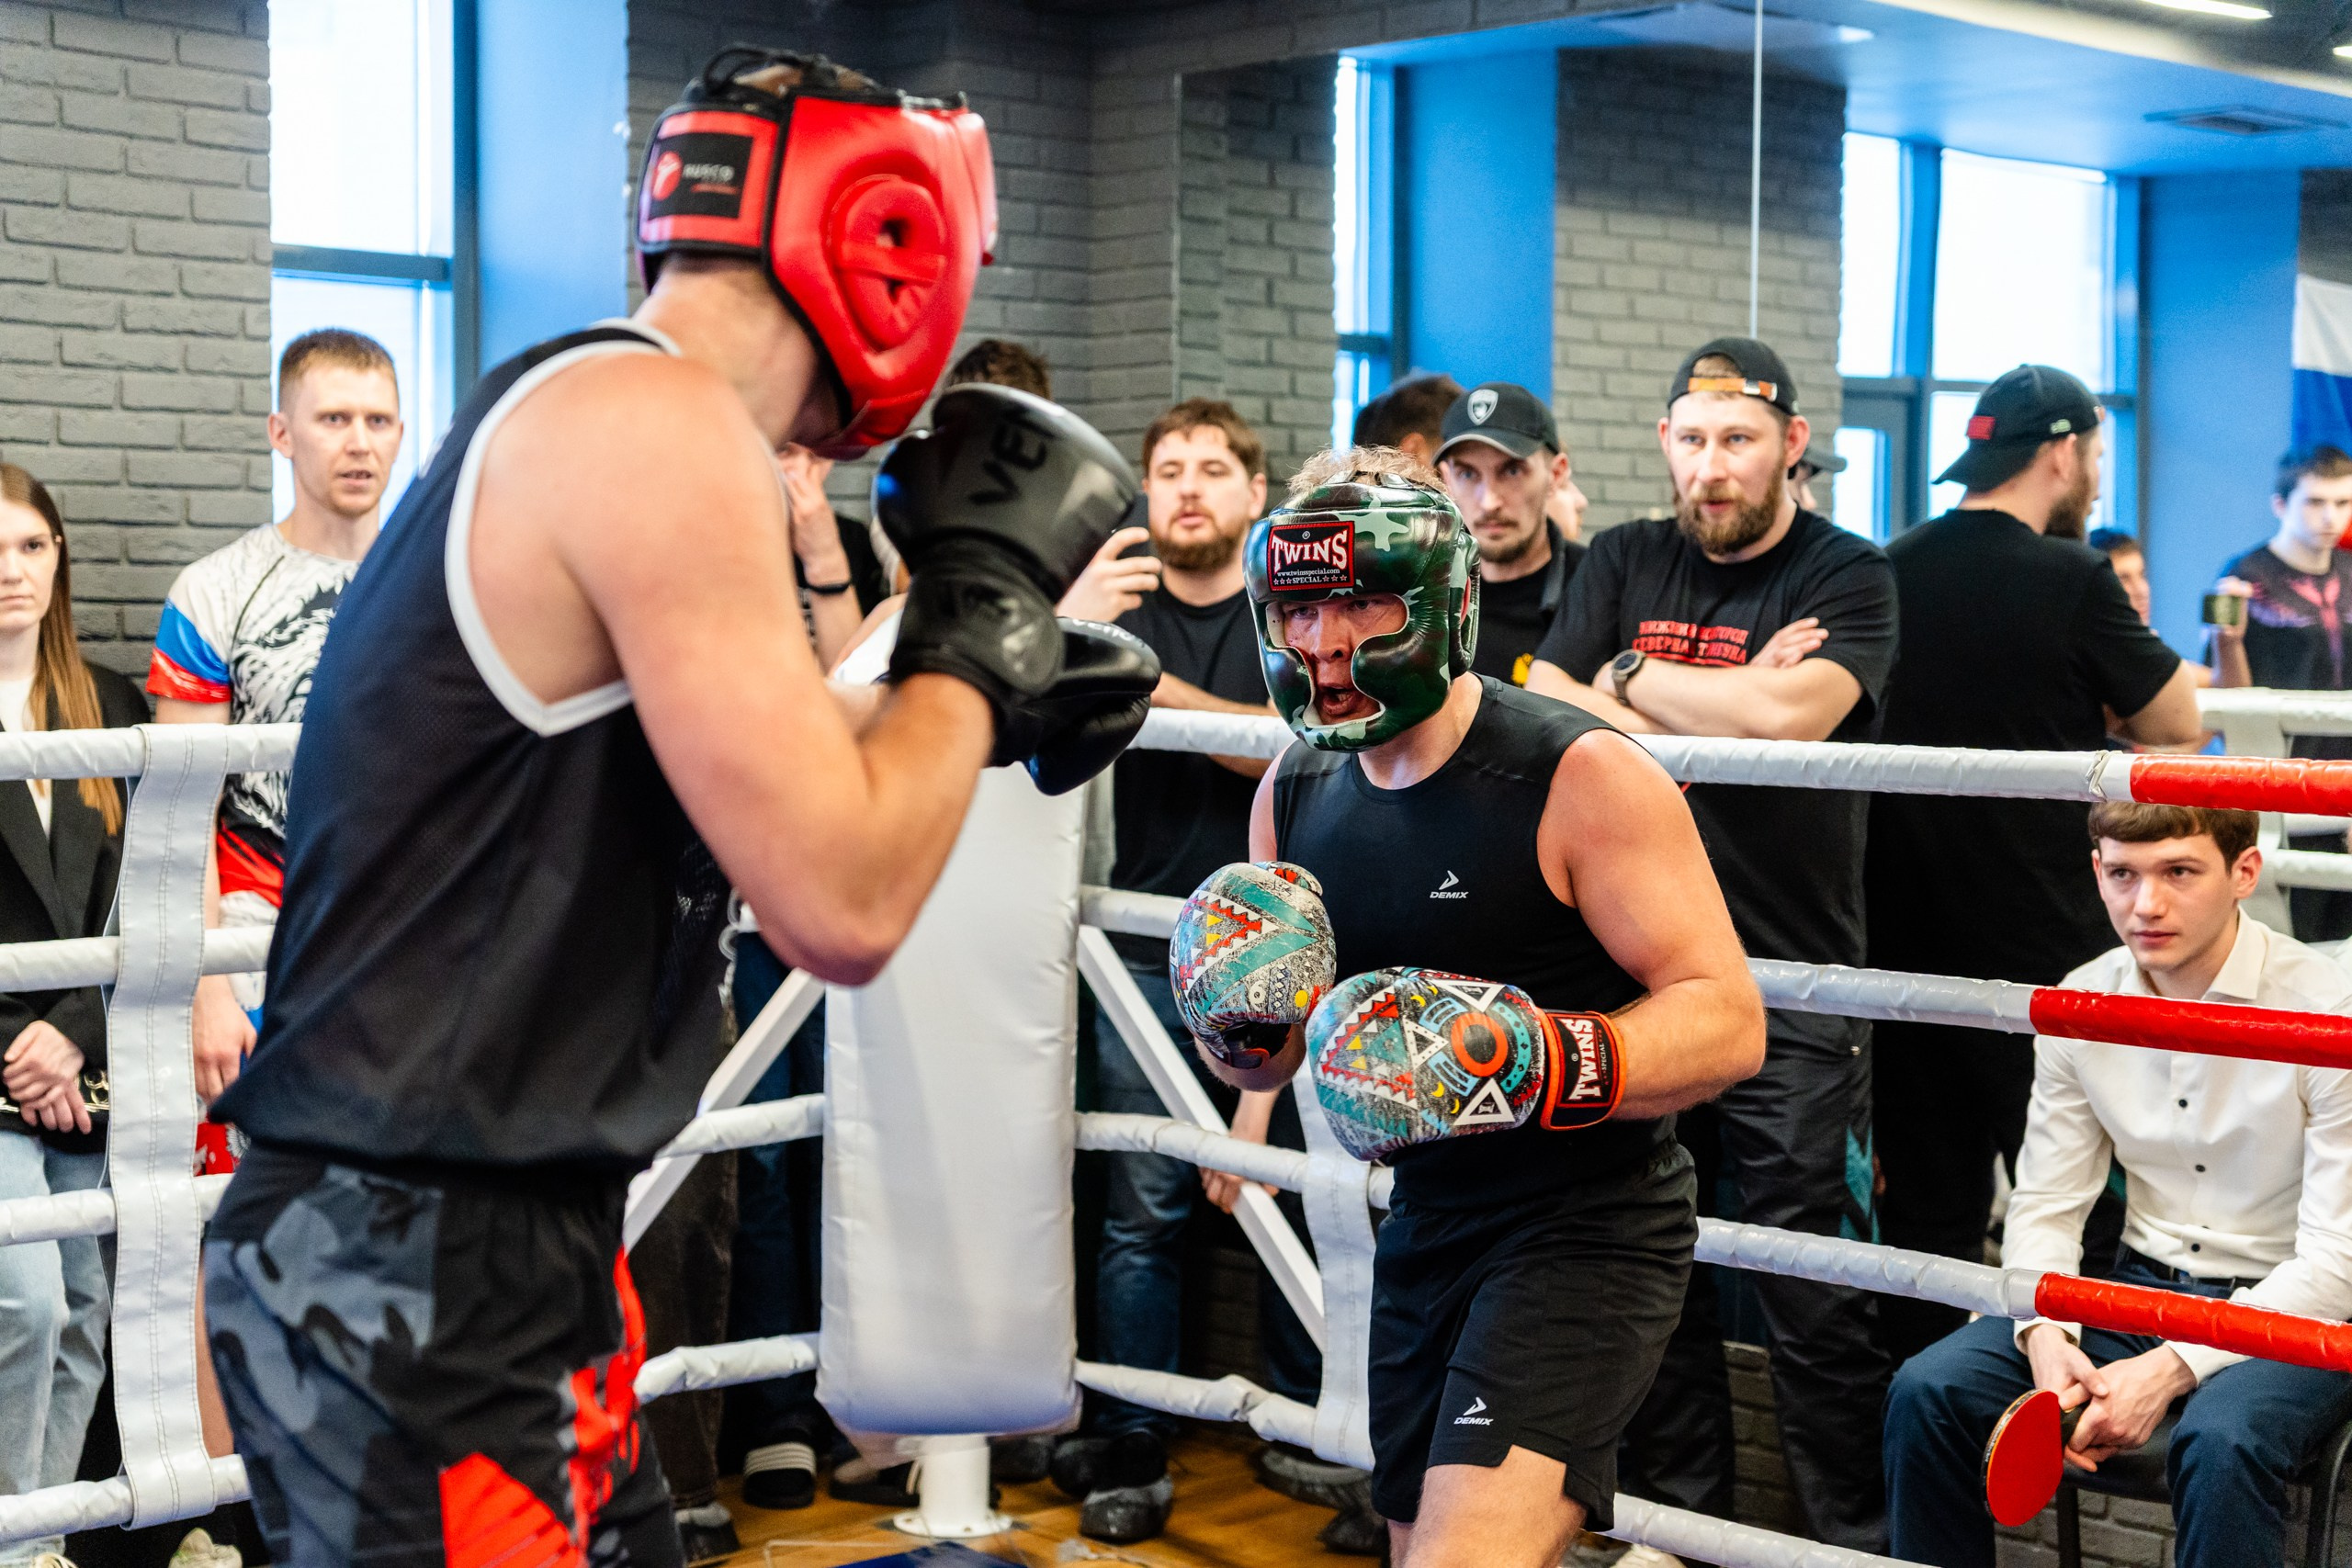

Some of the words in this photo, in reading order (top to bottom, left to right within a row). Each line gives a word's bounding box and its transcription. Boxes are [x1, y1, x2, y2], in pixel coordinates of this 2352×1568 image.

[1272, 529, 1348, 575] TWINS
[1277, 568, 1340, 577] www.twinsspecial.com
[1292, 576, 1322, 584] SPECIAL
[1430, 891, 1469, 899] DEMIX
[1558, 1018, 1601, 1100] TWINS
[1599, 1043, 1607, 1071] SPECIAL
[1453, 1417, 1494, 1426] DEMIX
